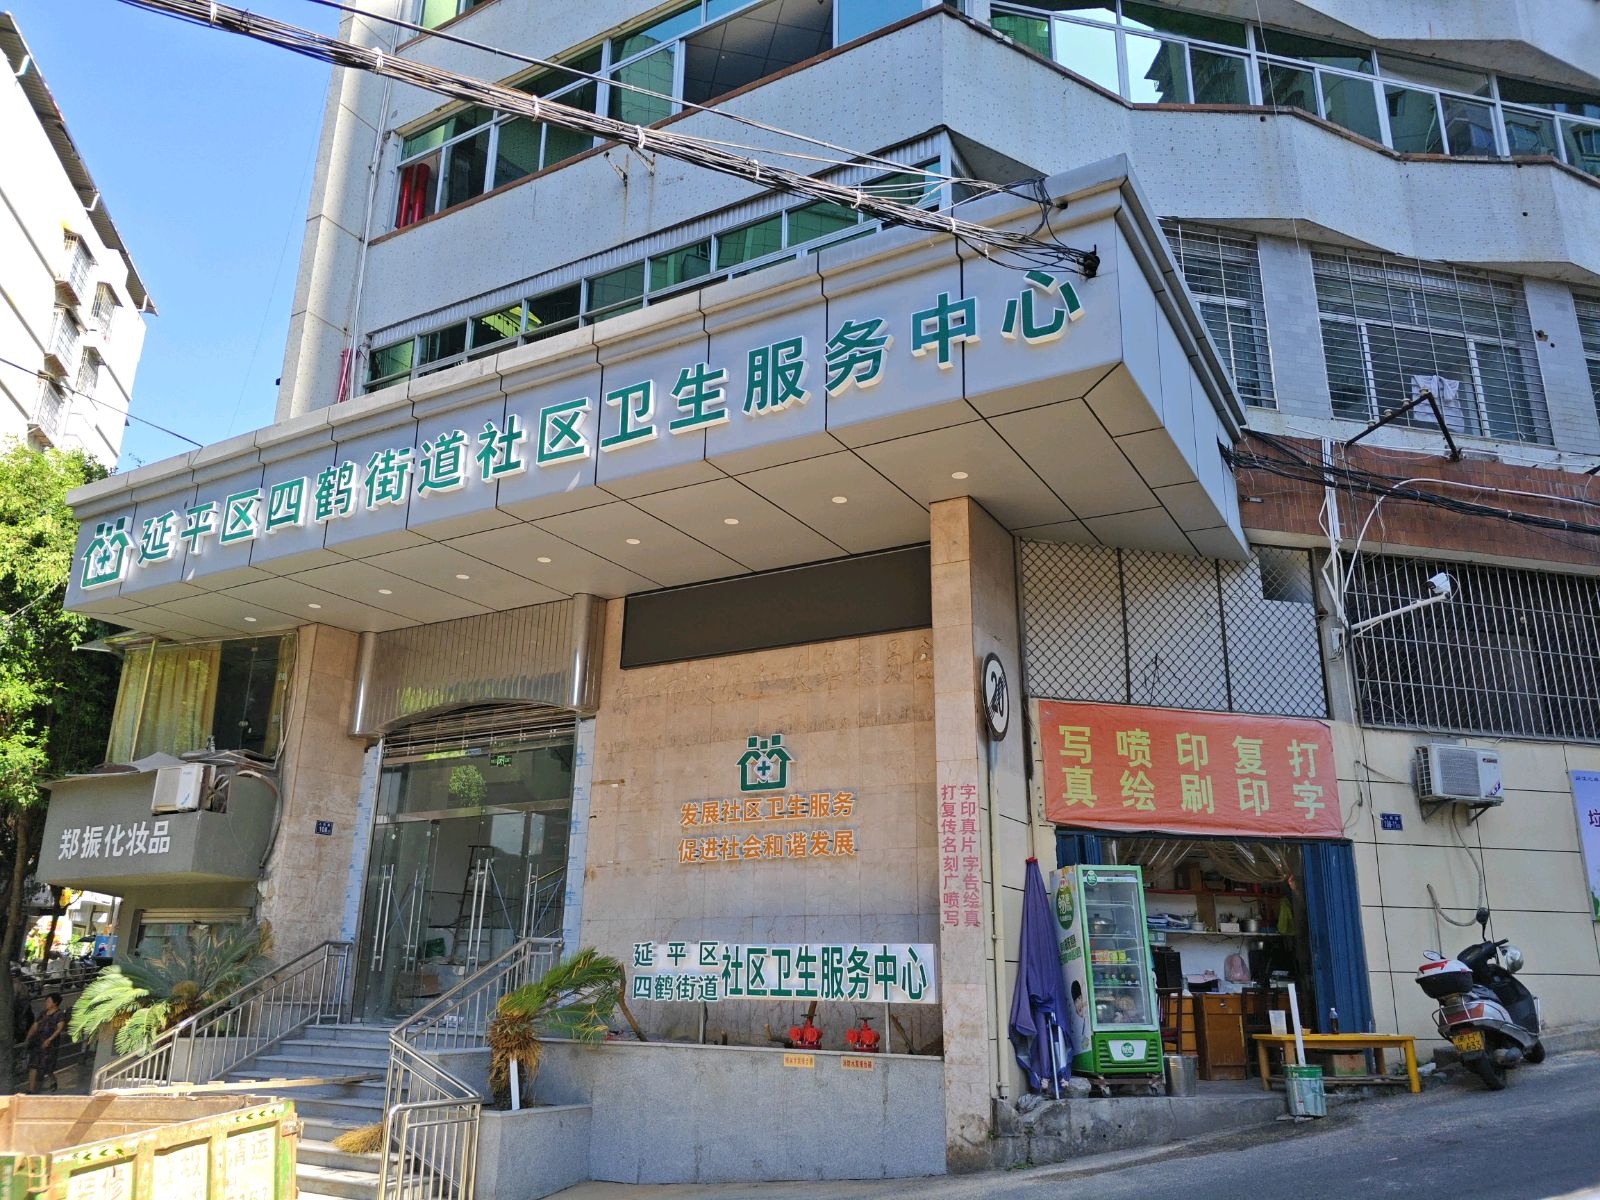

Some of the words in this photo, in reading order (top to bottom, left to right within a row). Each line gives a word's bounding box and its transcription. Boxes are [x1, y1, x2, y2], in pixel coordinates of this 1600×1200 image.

[136, 270, 1085, 568] 延平区四鹤街道社区卫生服务中心
[679, 791, 855, 827] 发展社区卫生服务
[58, 820, 171, 860] 郑振化妆品
[678, 829, 856, 864] 促进社会和谐发展
[633, 941, 719, 968] 延平区
[633, 974, 719, 1001] 四鹤街道
[721, 945, 928, 1001] 社区卫生服务中心
